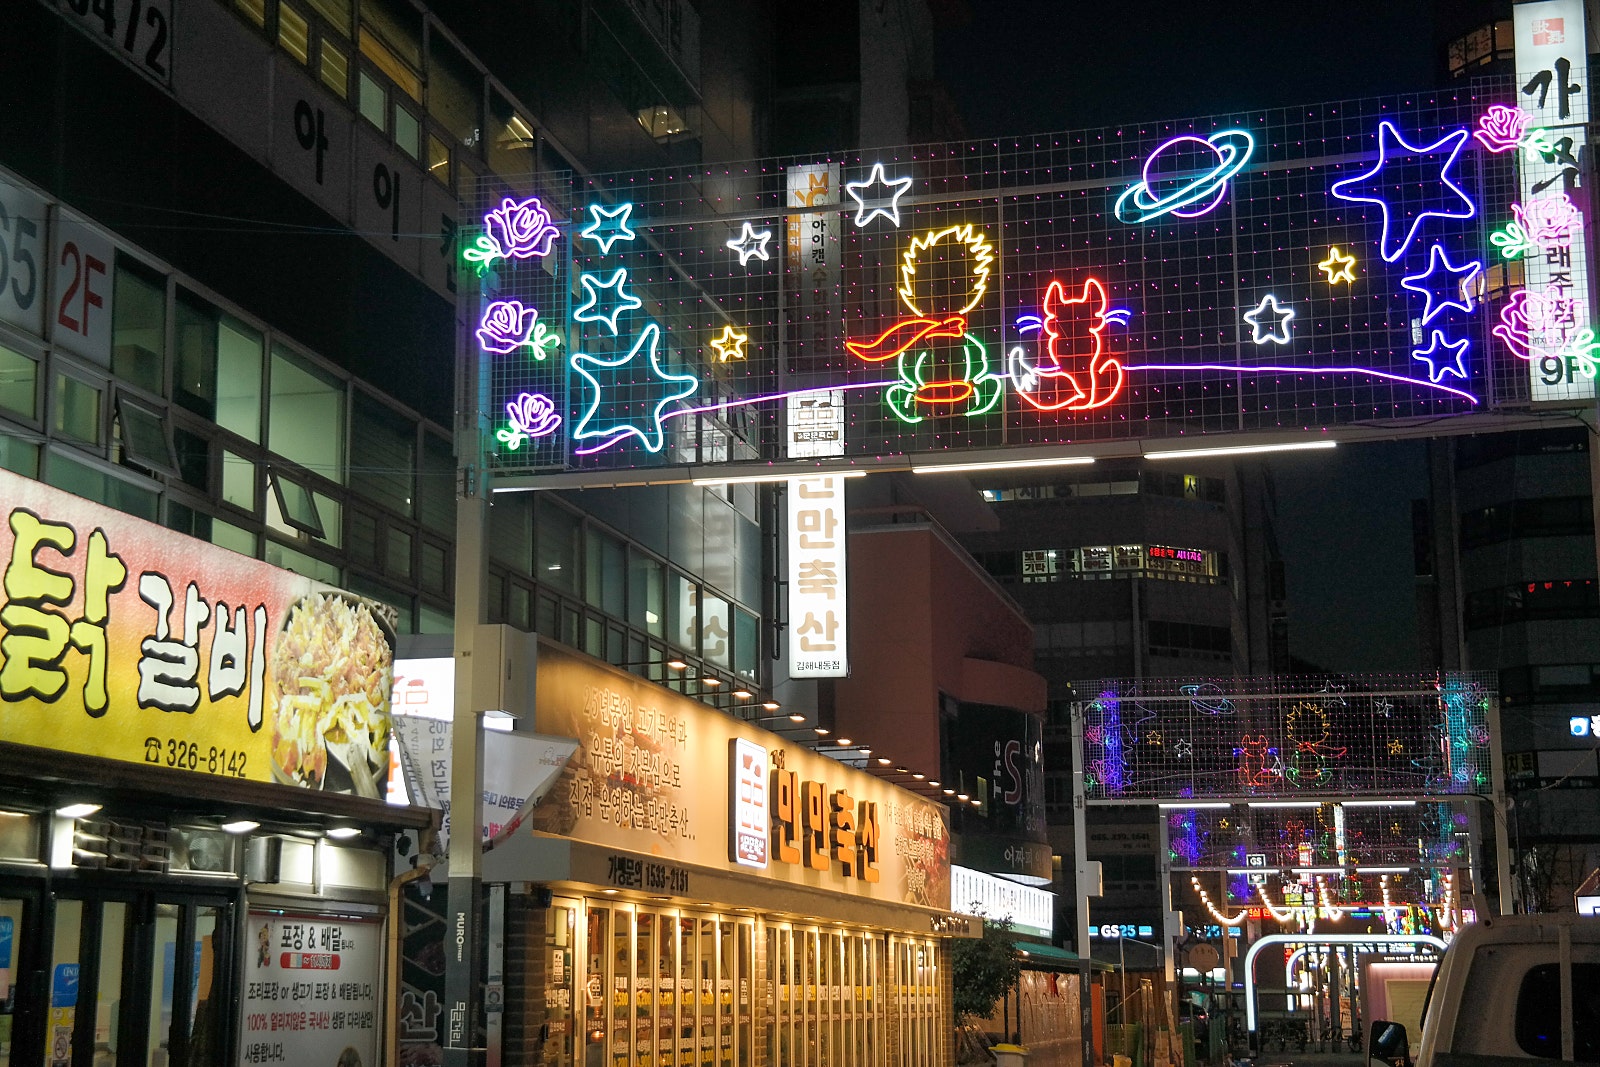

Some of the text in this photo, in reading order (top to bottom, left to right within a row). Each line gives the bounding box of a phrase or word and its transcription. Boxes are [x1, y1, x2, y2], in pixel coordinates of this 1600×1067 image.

[812, 219, 827, 264] 아이캔
[58, 241, 106, 337] 2F
[796, 661, 840, 671] 김해내동점
[583, 687, 687, 751] 25년동안 고기무역과
[165, 738, 248, 779] 326-8142
[591, 734, 682, 789] 유통의 자부심으로
[993, 740, 1002, 799] The
[570, 779, 594, 818] 직접
[600, 787, 645, 829] 운영하는
[770, 768, 880, 884] 만만축산
[608, 854, 689, 893] 가맹문의 1533-2131
[281, 924, 304, 950] 포장
[308, 926, 316, 949] &
[321, 926, 342, 952] 배달
[1100, 924, 1137, 939] GS25
[248, 981, 374, 1001] 조리포장 or 생고기 포장 & 배달됩니다.
[247, 1011, 373, 1032] 100% 얼리지않은 국내산 생닭 다리살만
[245, 1043, 285, 1064] 사용합니다.
